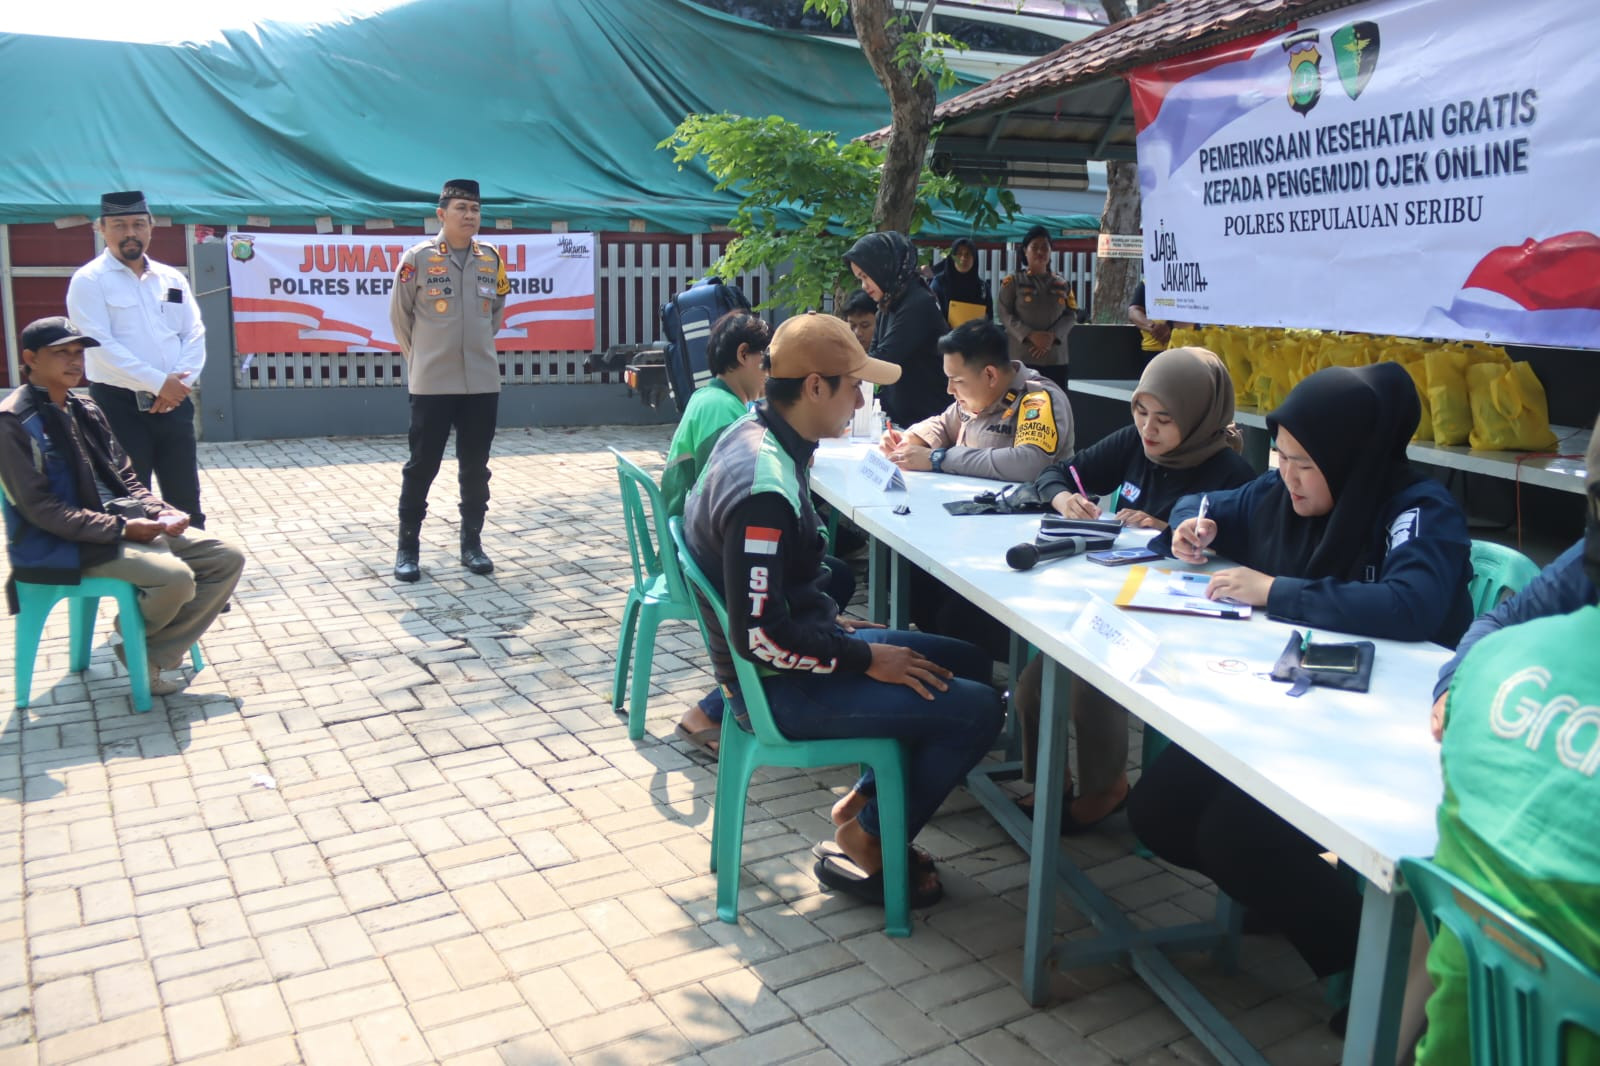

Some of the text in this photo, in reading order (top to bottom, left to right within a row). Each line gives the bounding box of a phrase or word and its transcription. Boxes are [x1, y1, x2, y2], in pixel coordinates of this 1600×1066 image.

[1199, 89, 1538, 174] PEMERIKSAAN KESEHATAN GRATIS
[1203, 137, 1530, 205] KEPADA PENGEMUDI OJEK ONLINE
[1223, 195, 1484, 236] POLRES KEPULAUAN SERIBU
[299, 244, 526, 272] JUMAT LI
[1150, 229, 1178, 262] JAGA
[269, 278, 350, 295] POLRES
[356, 278, 393, 295] KEP
[508, 277, 554, 295] RIBU
[427, 276, 451, 284] ARGA
[1490, 665, 1600, 779] Gra
